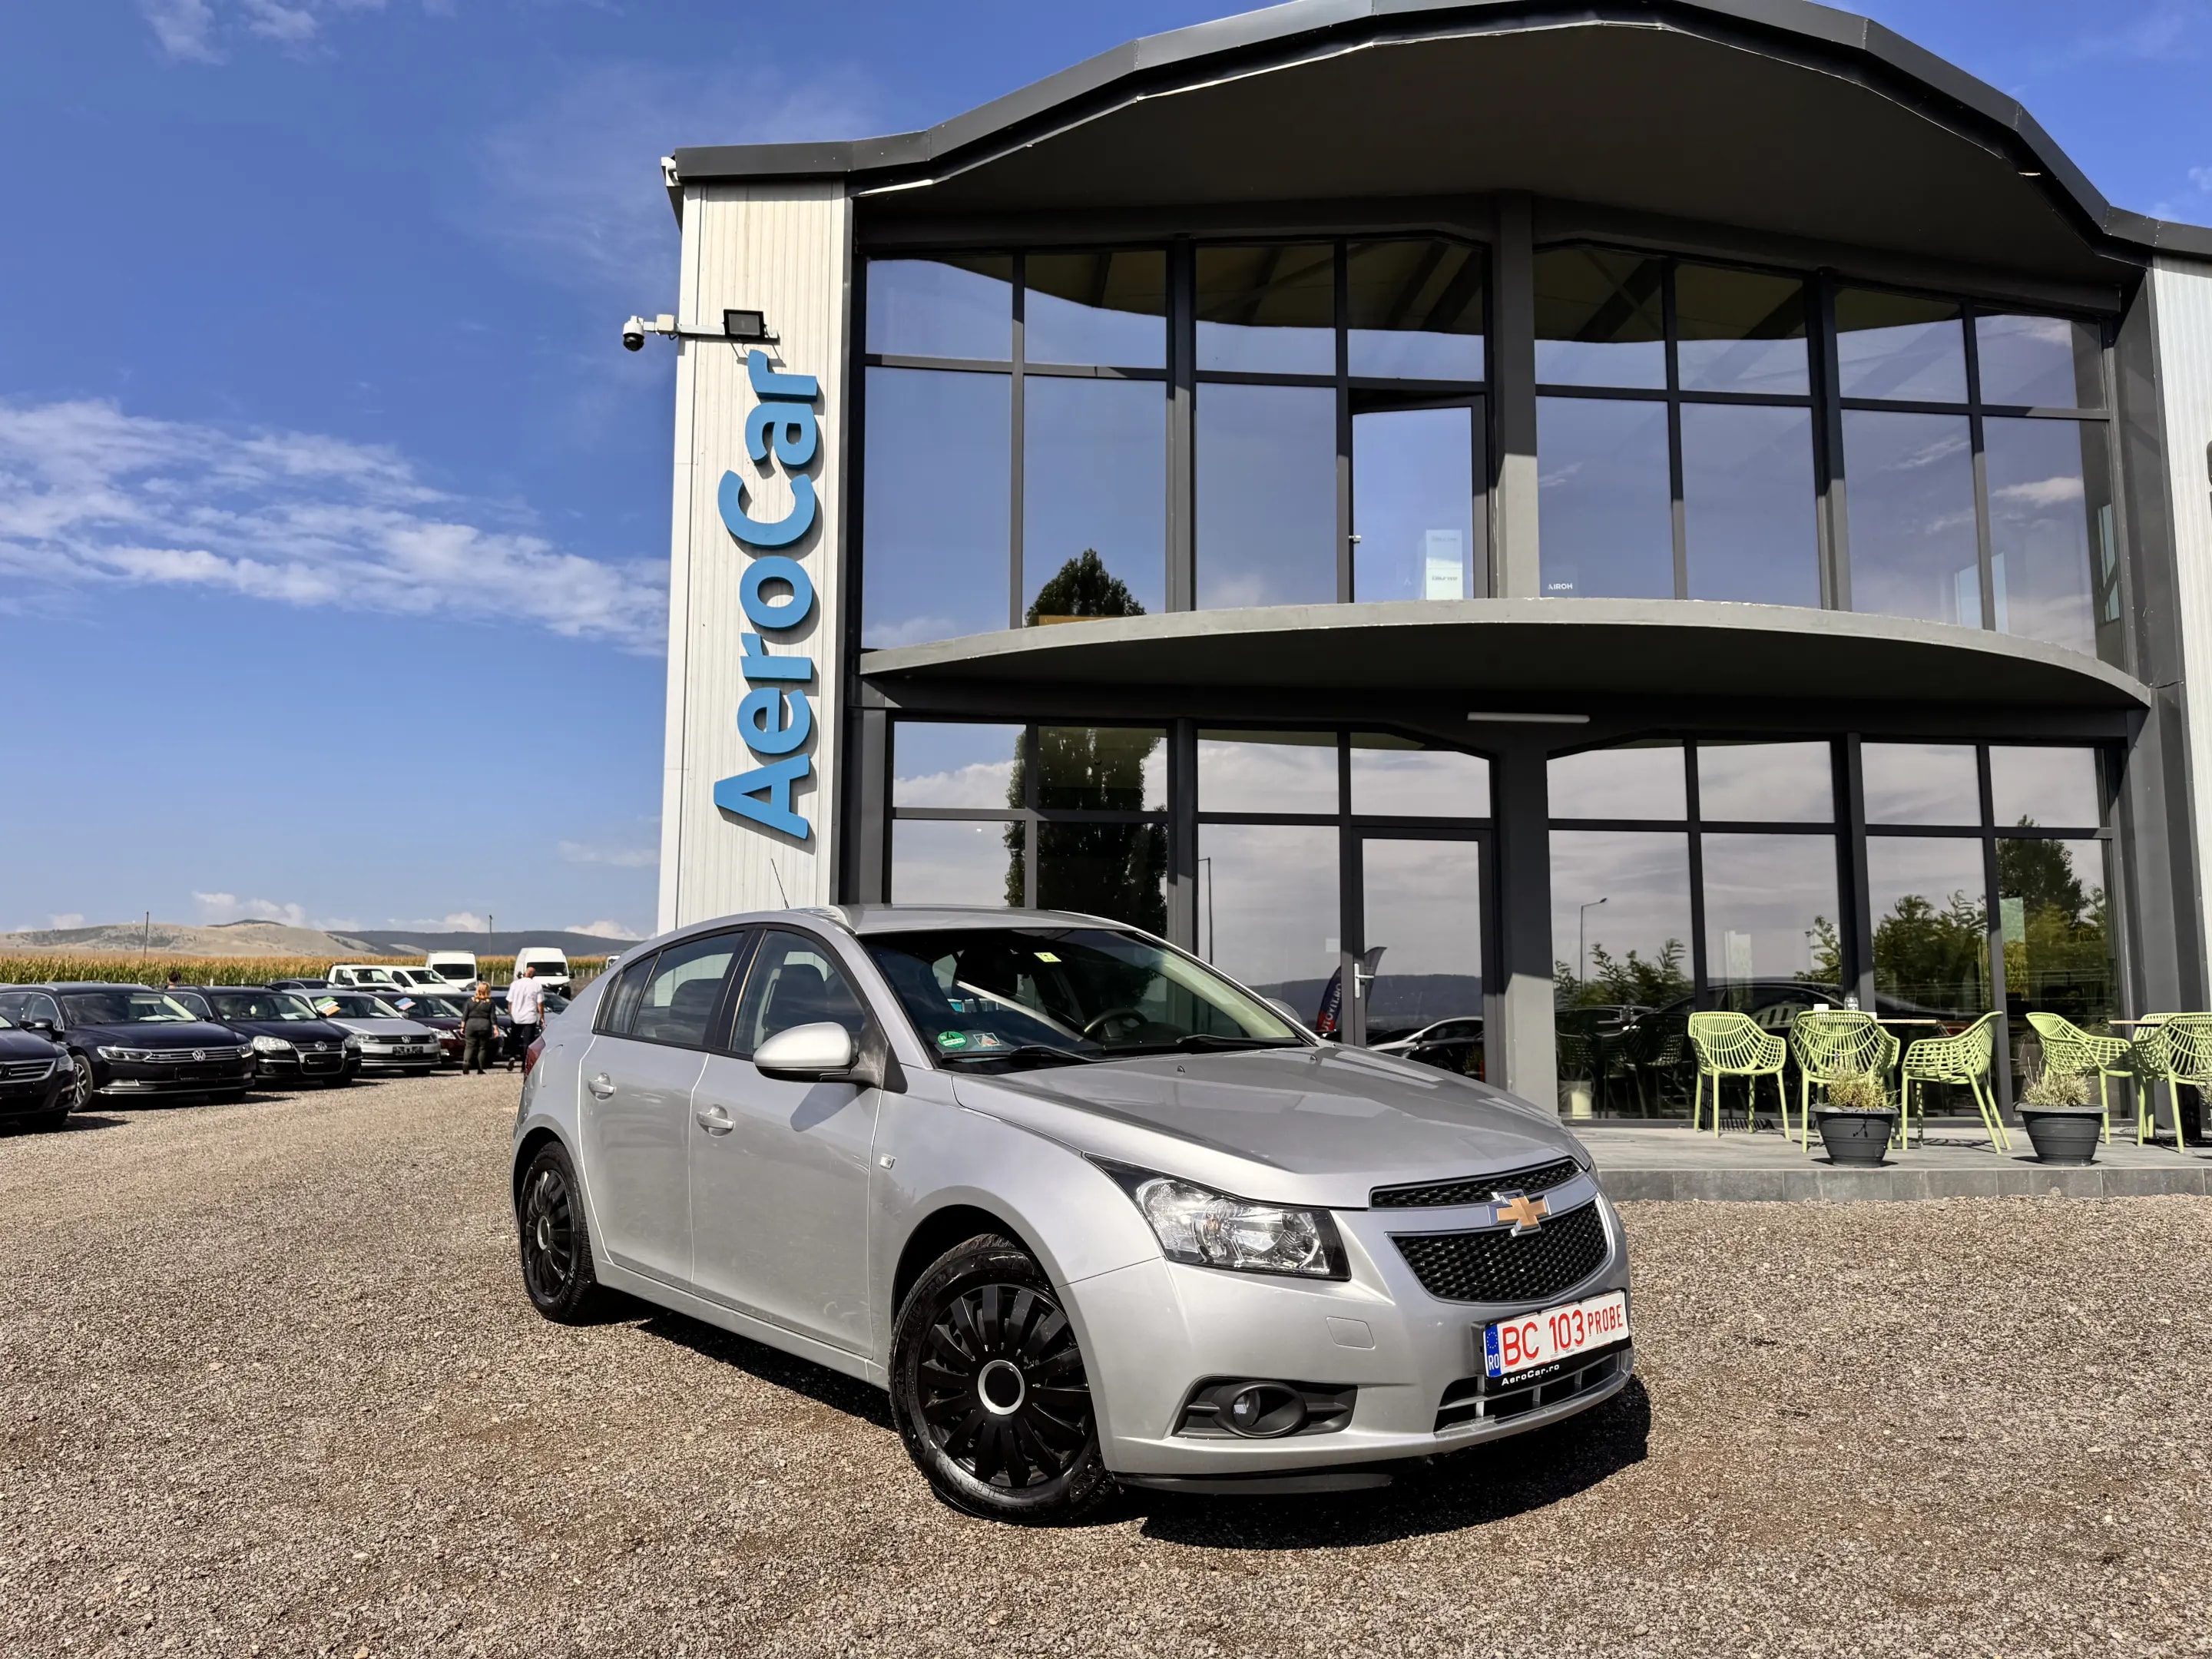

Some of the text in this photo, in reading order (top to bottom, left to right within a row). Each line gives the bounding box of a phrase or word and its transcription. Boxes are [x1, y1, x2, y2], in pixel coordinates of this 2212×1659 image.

[714, 349, 817, 839] AeroCar
[1502, 1304, 1623, 1366] BC 103 PROBE
[1488, 1353, 1500, 1370] RO
[1502, 1364, 1559, 1386] AeroCar.ro
